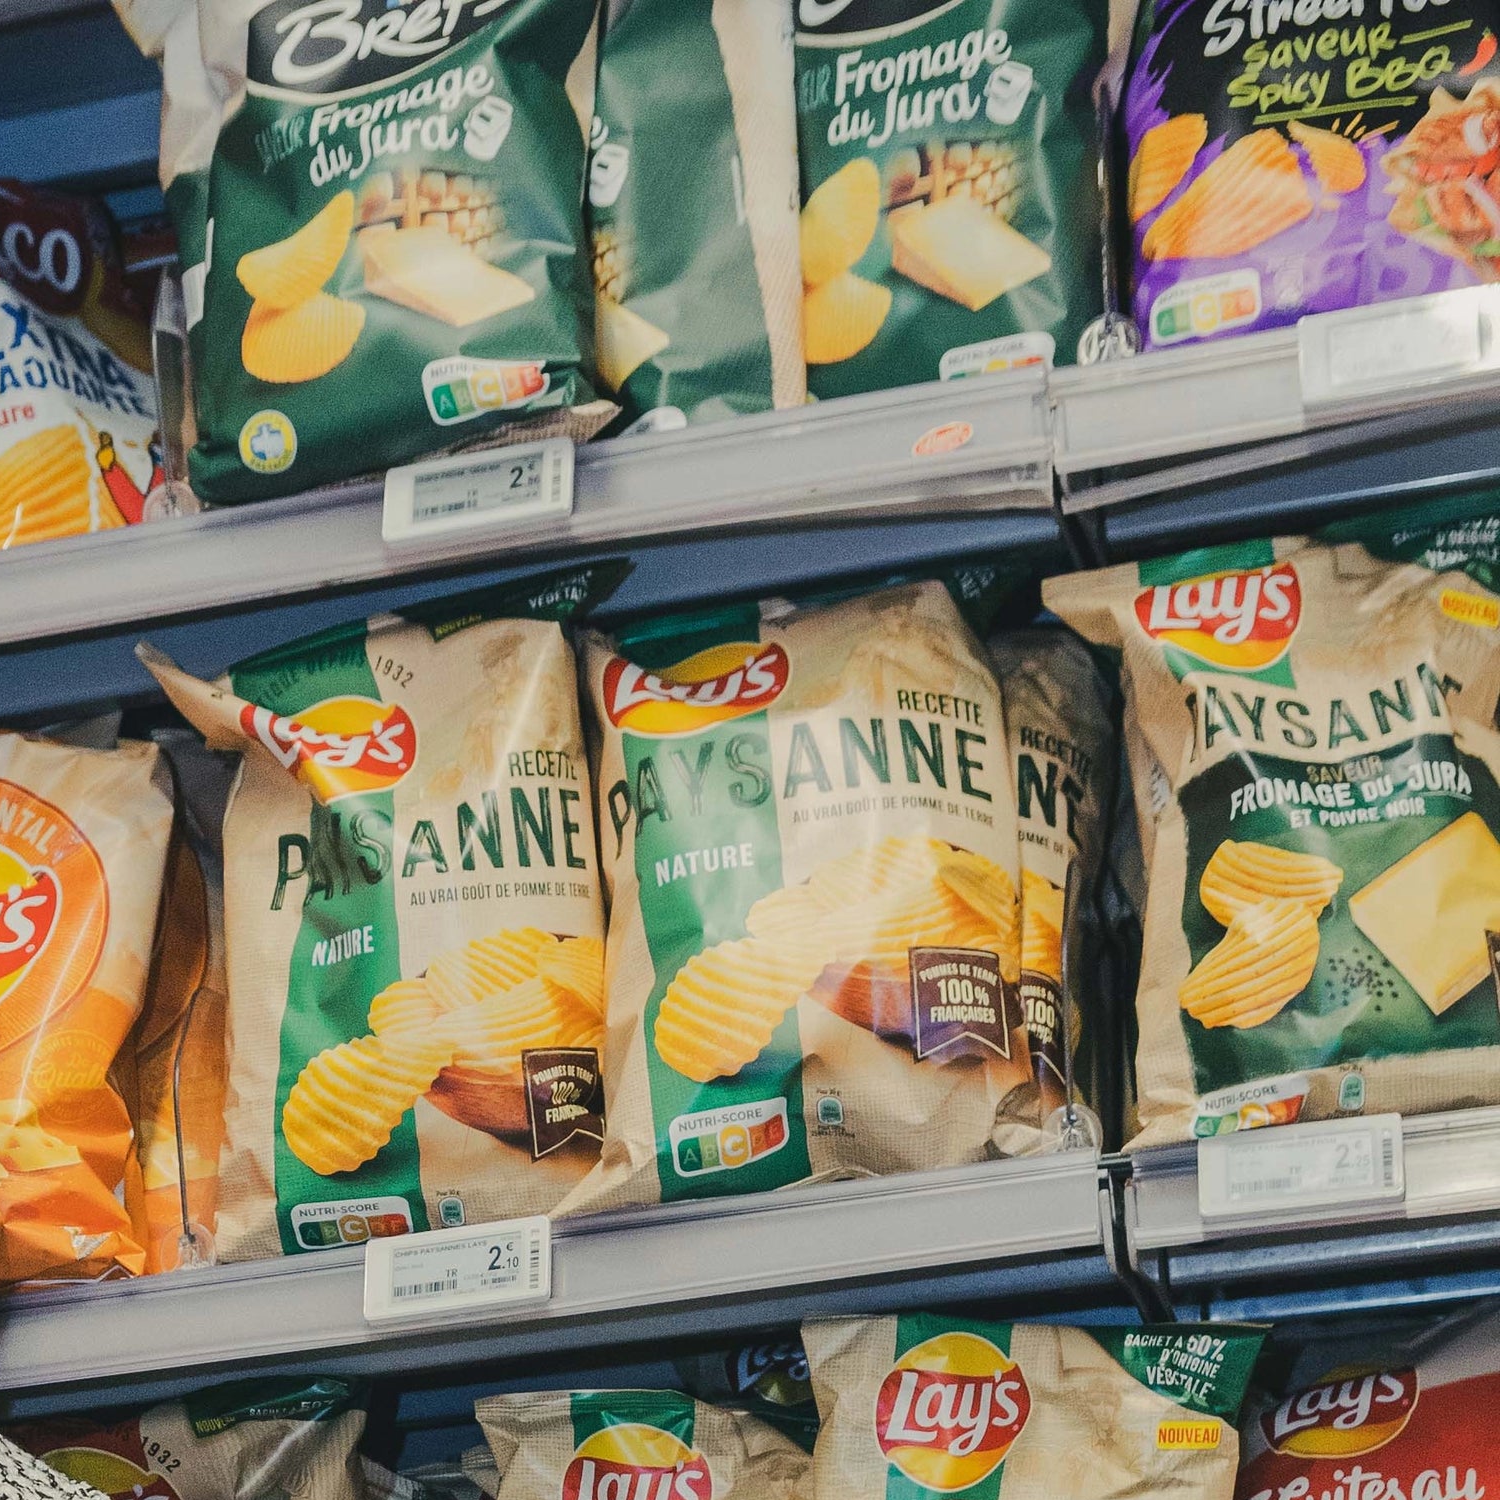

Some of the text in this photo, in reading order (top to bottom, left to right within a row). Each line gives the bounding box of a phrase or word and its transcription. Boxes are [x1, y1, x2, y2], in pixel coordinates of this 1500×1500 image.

[834, 29, 1012, 106] Fromage
[1346, 45, 1455, 98] BBQ
[309, 65, 495, 146] Fromage
[827, 82, 984, 149] du Jura
[310, 112, 459, 188] du Jura
[373, 655, 416, 690] 1932
[897, 689, 985, 729] RECETTE
[253, 706, 408, 771] Lay's
[1306, 755, 1383, 784] SAVEUR
[607, 716, 993, 861] PAYSANNE
[1230, 761, 1473, 822] FROMAGE DU JURA
[792, 796, 994, 828] AU VRAI GOÛT DE POMME DE TERRE
[1290, 796, 1426, 829] ET POIVRE NOIR
[655, 842, 754, 888] NATURE
[410, 882, 592, 907] AU VRAI GOÛT DE POMME DE TERRE
[311, 923, 375, 967] NATURE
[918, 962, 999, 987] POMMES DE TERRE
[936, 977, 990, 1007] 100%
[930, 1004, 996, 1025] FRANÇAISES
[533, 1064, 568, 1086] POMMES
[567, 1064, 577, 1077] DE
[1204, 1083, 1279, 1111] NUTRI-SCORE
[677, 1106, 764, 1133] NUTRI-SCORE
[298, 1202, 381, 1219] NUTRI-SCORE
[1124, 1333, 1174, 1349] SACHET
[1158, 1347, 1222, 1380] D'ORIGINE
[884, 1368, 1022, 1458] Lay's
[1157, 1426, 1220, 1445] NOUVEAU
[140, 1435, 183, 1475] 1932
